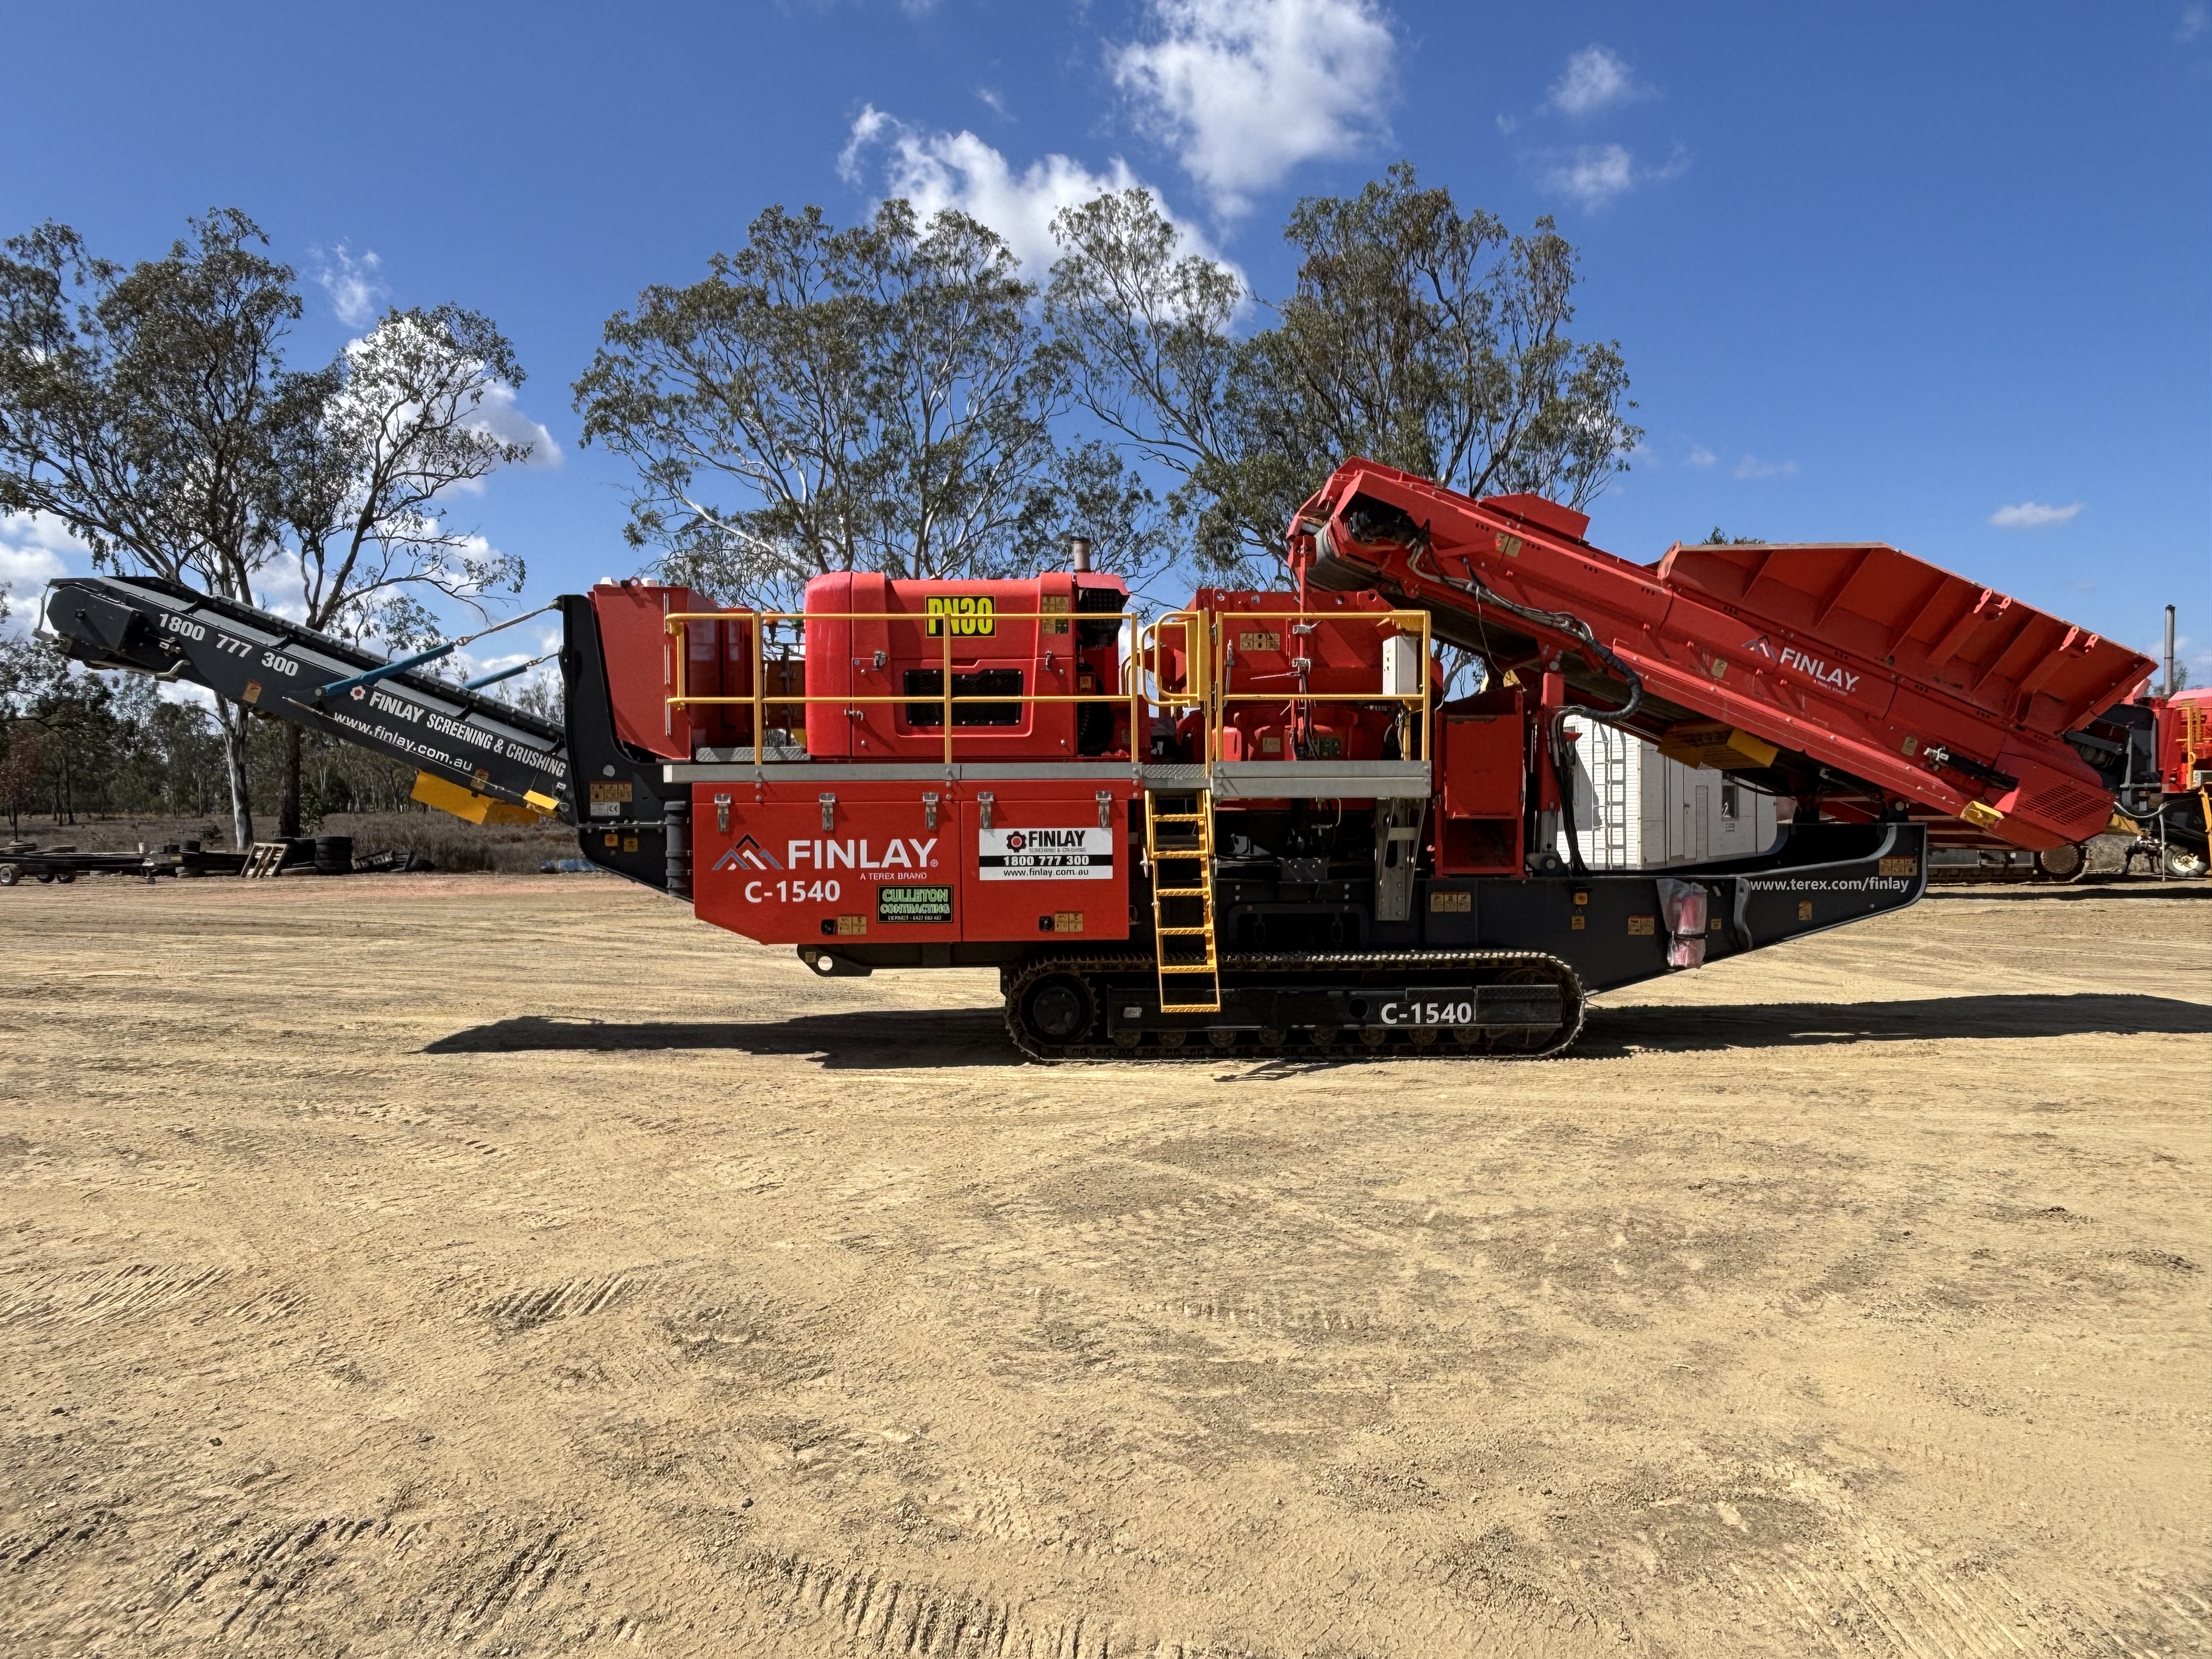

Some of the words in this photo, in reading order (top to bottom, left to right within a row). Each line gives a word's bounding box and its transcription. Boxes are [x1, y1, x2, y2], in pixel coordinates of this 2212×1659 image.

[159, 613, 205, 641] 1800
[216, 633, 252, 657] 777
[262, 652, 298, 676] 300
[1780, 647, 1859, 690] FINLAY
[334, 712, 472, 771] www.finlay.com.au
[369, 691, 425, 723] FINLAY
[427, 713, 493, 749] SCREENING
[494, 738, 503, 754] &
[506, 743, 566, 777] CRUSHING
[1028, 830, 1086, 847] FINLAY
[788, 838, 938, 870] FINLAY
[1003, 856, 1035, 866] 1800
[1039, 856, 1062, 866] 777
[1066, 855, 1090, 866] 300
[1003, 868, 1089, 878] www.finlay.com.au
[744, 880, 840, 903] C-1540
[1750, 877, 1909, 893] www.terex.com/finlay
[1381, 1002, 1472, 1024] C-1540
